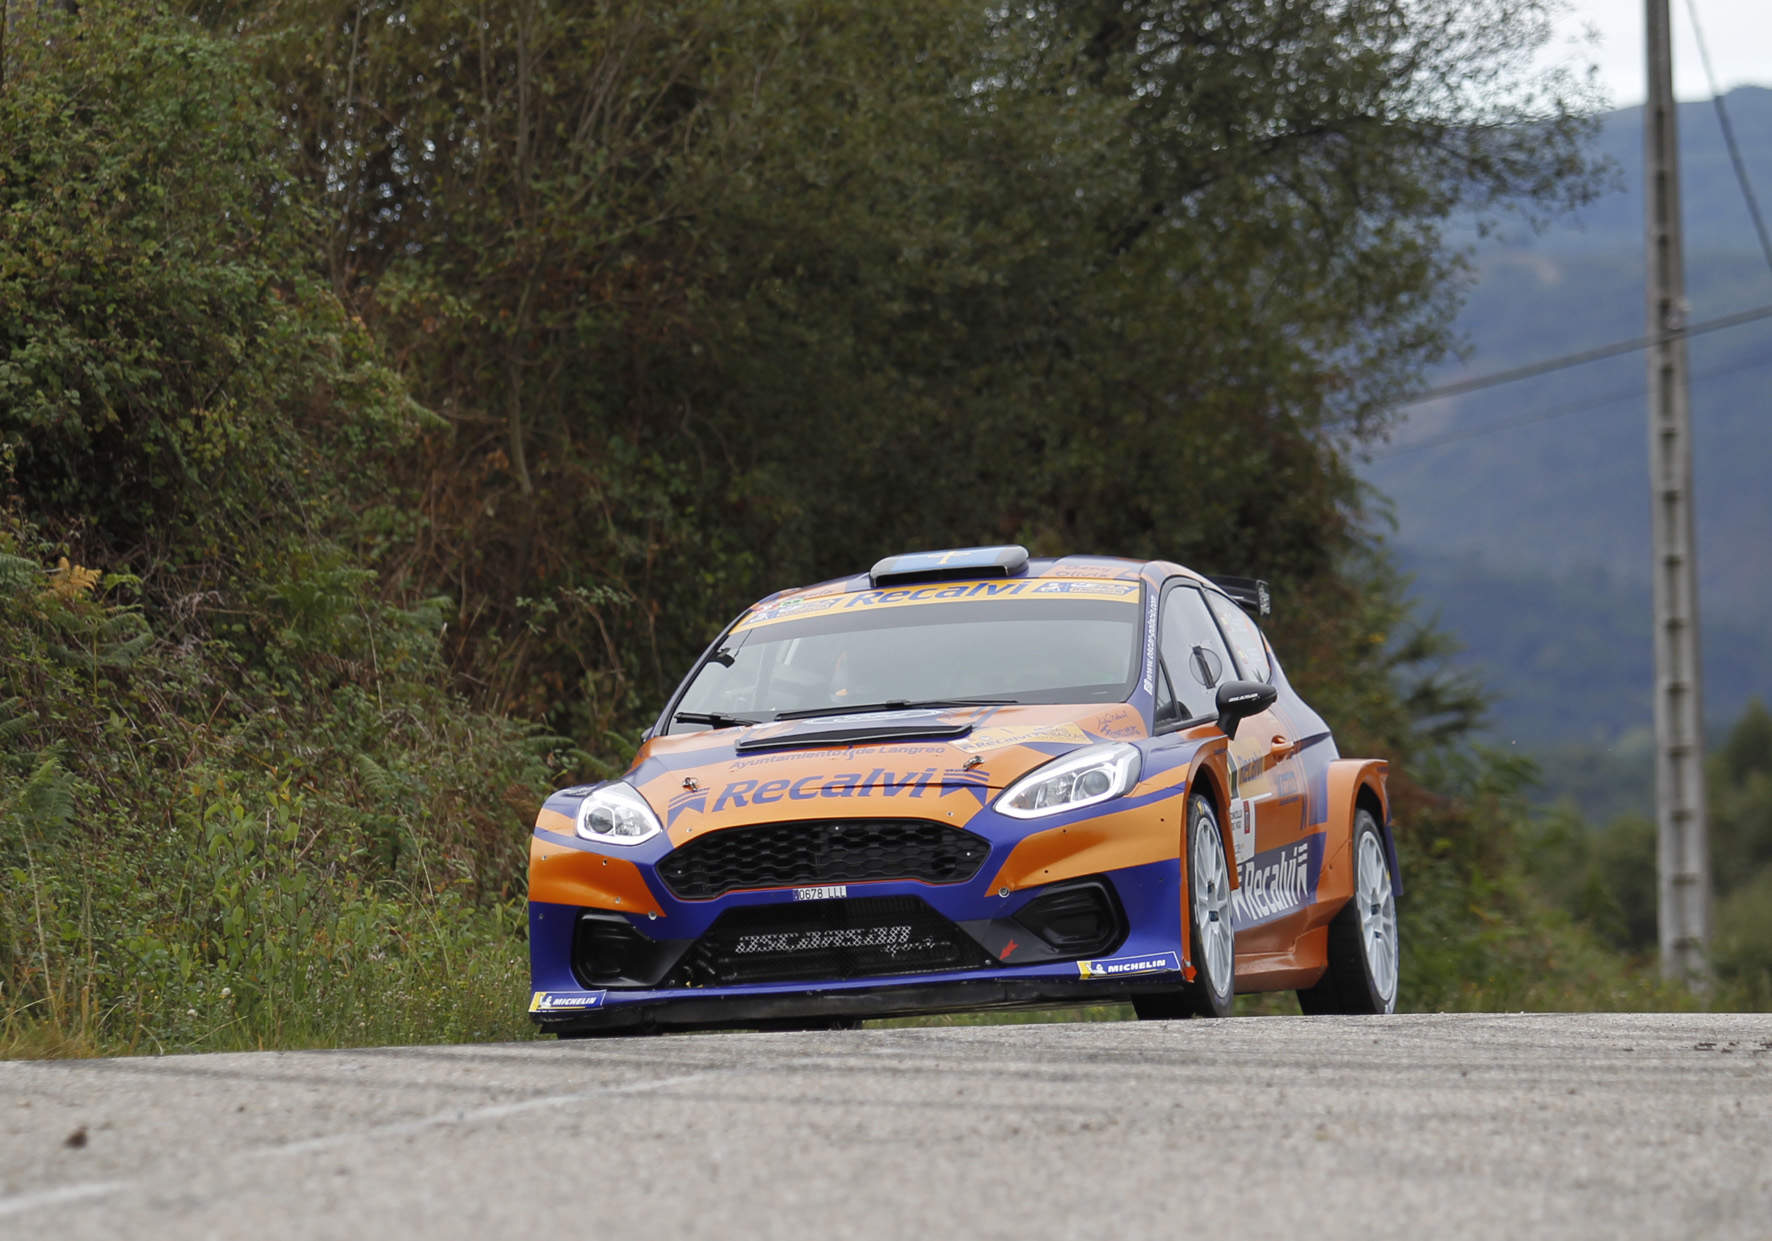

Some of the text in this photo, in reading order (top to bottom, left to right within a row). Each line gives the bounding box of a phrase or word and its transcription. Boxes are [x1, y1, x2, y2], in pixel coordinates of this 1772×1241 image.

[845, 581, 1033, 608] Recalvi
[730, 745, 946, 770] Ayuntamiento de Langreo
[711, 767, 938, 813] Recalvi
[799, 887, 824, 900] 0678
[1244, 846, 1299, 920] Recalvi
[1107, 959, 1167, 974] MICHELIN
[552, 995, 598, 1006] MICHELIN
